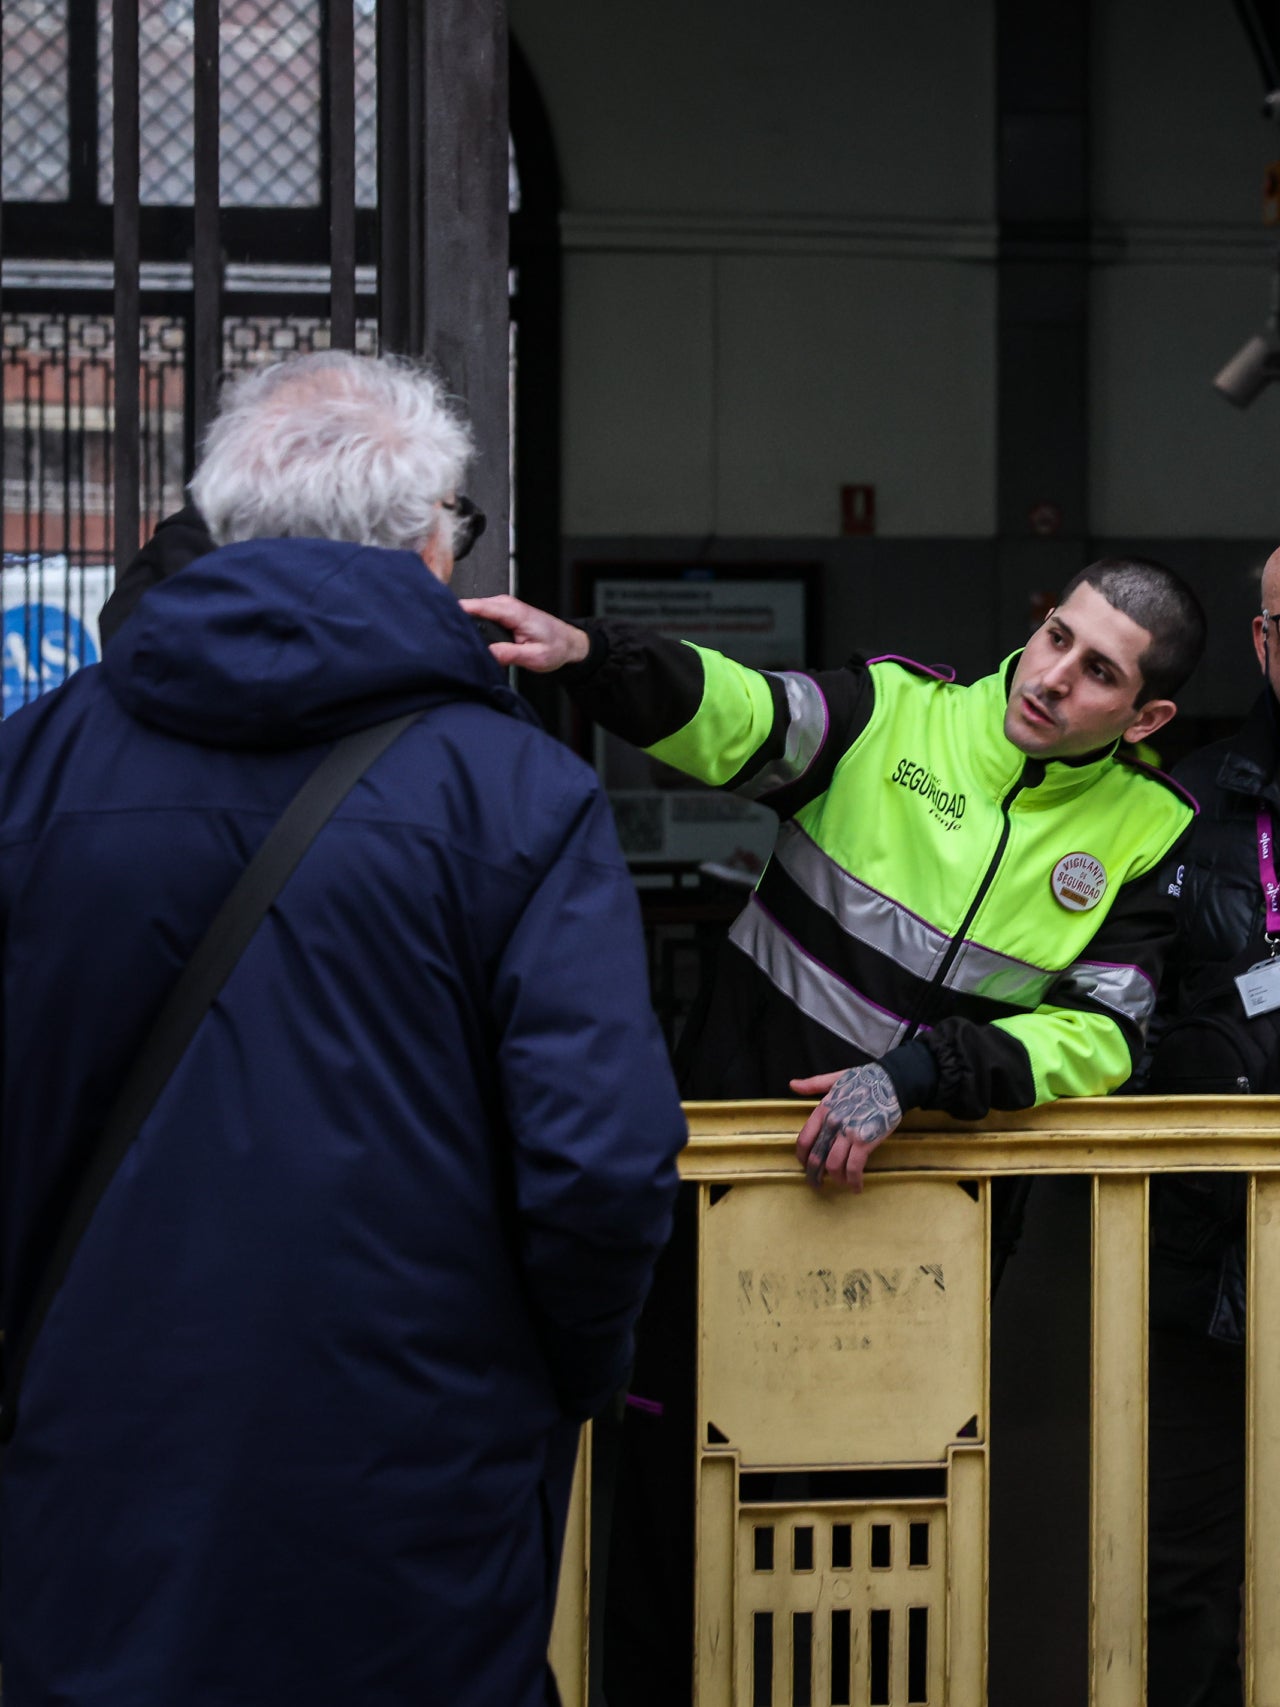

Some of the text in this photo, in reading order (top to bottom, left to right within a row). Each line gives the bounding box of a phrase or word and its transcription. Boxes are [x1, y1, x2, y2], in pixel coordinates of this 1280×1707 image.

[892, 758, 967, 819] SEGURIDAD
[1259, 832, 1272, 860] renfe
[1056, 871, 1101, 900] SEGURIDAD
[1063, 857, 1105, 887] VIGILANTE
